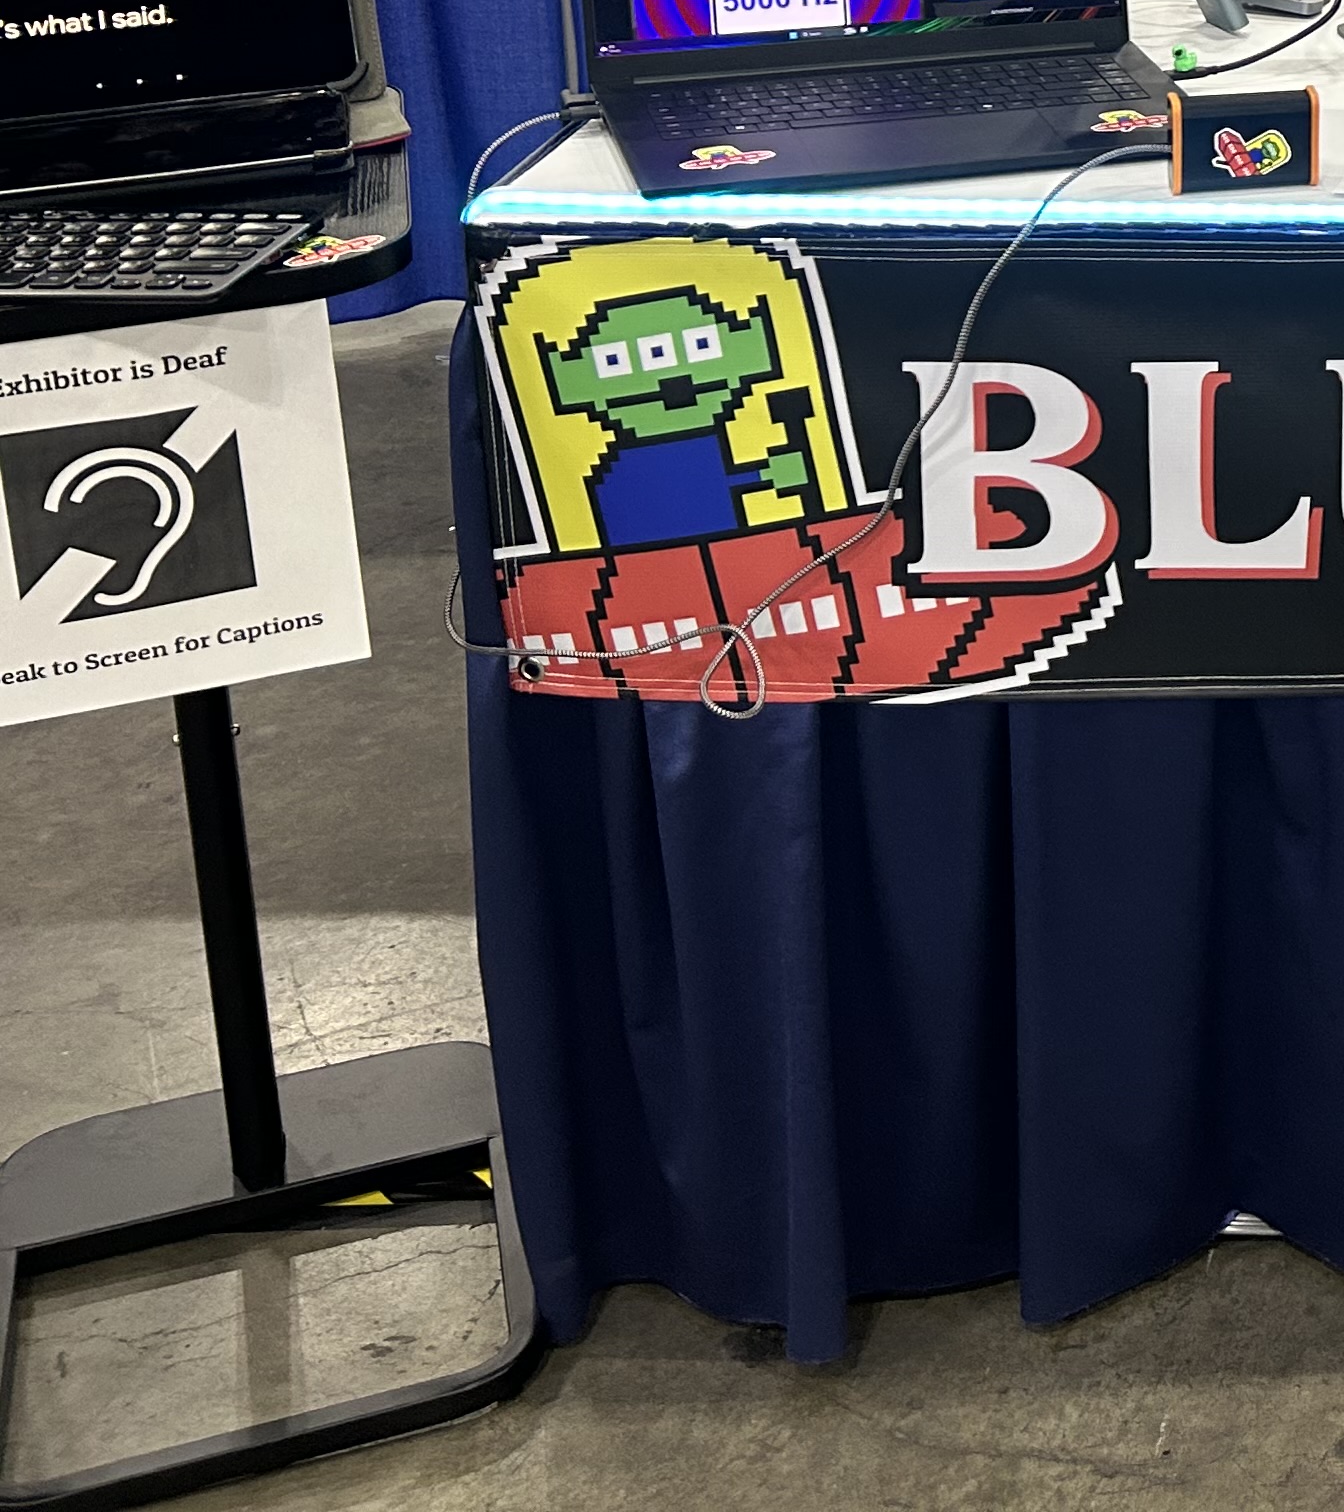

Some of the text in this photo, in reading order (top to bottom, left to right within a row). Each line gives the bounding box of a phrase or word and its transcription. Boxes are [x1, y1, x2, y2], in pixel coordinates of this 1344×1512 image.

[24, 4, 173, 36] what I said.
[131, 360, 154, 380] is
[162, 346, 228, 375] Deaf
[52, 612, 324, 676] to Screen for Captions
